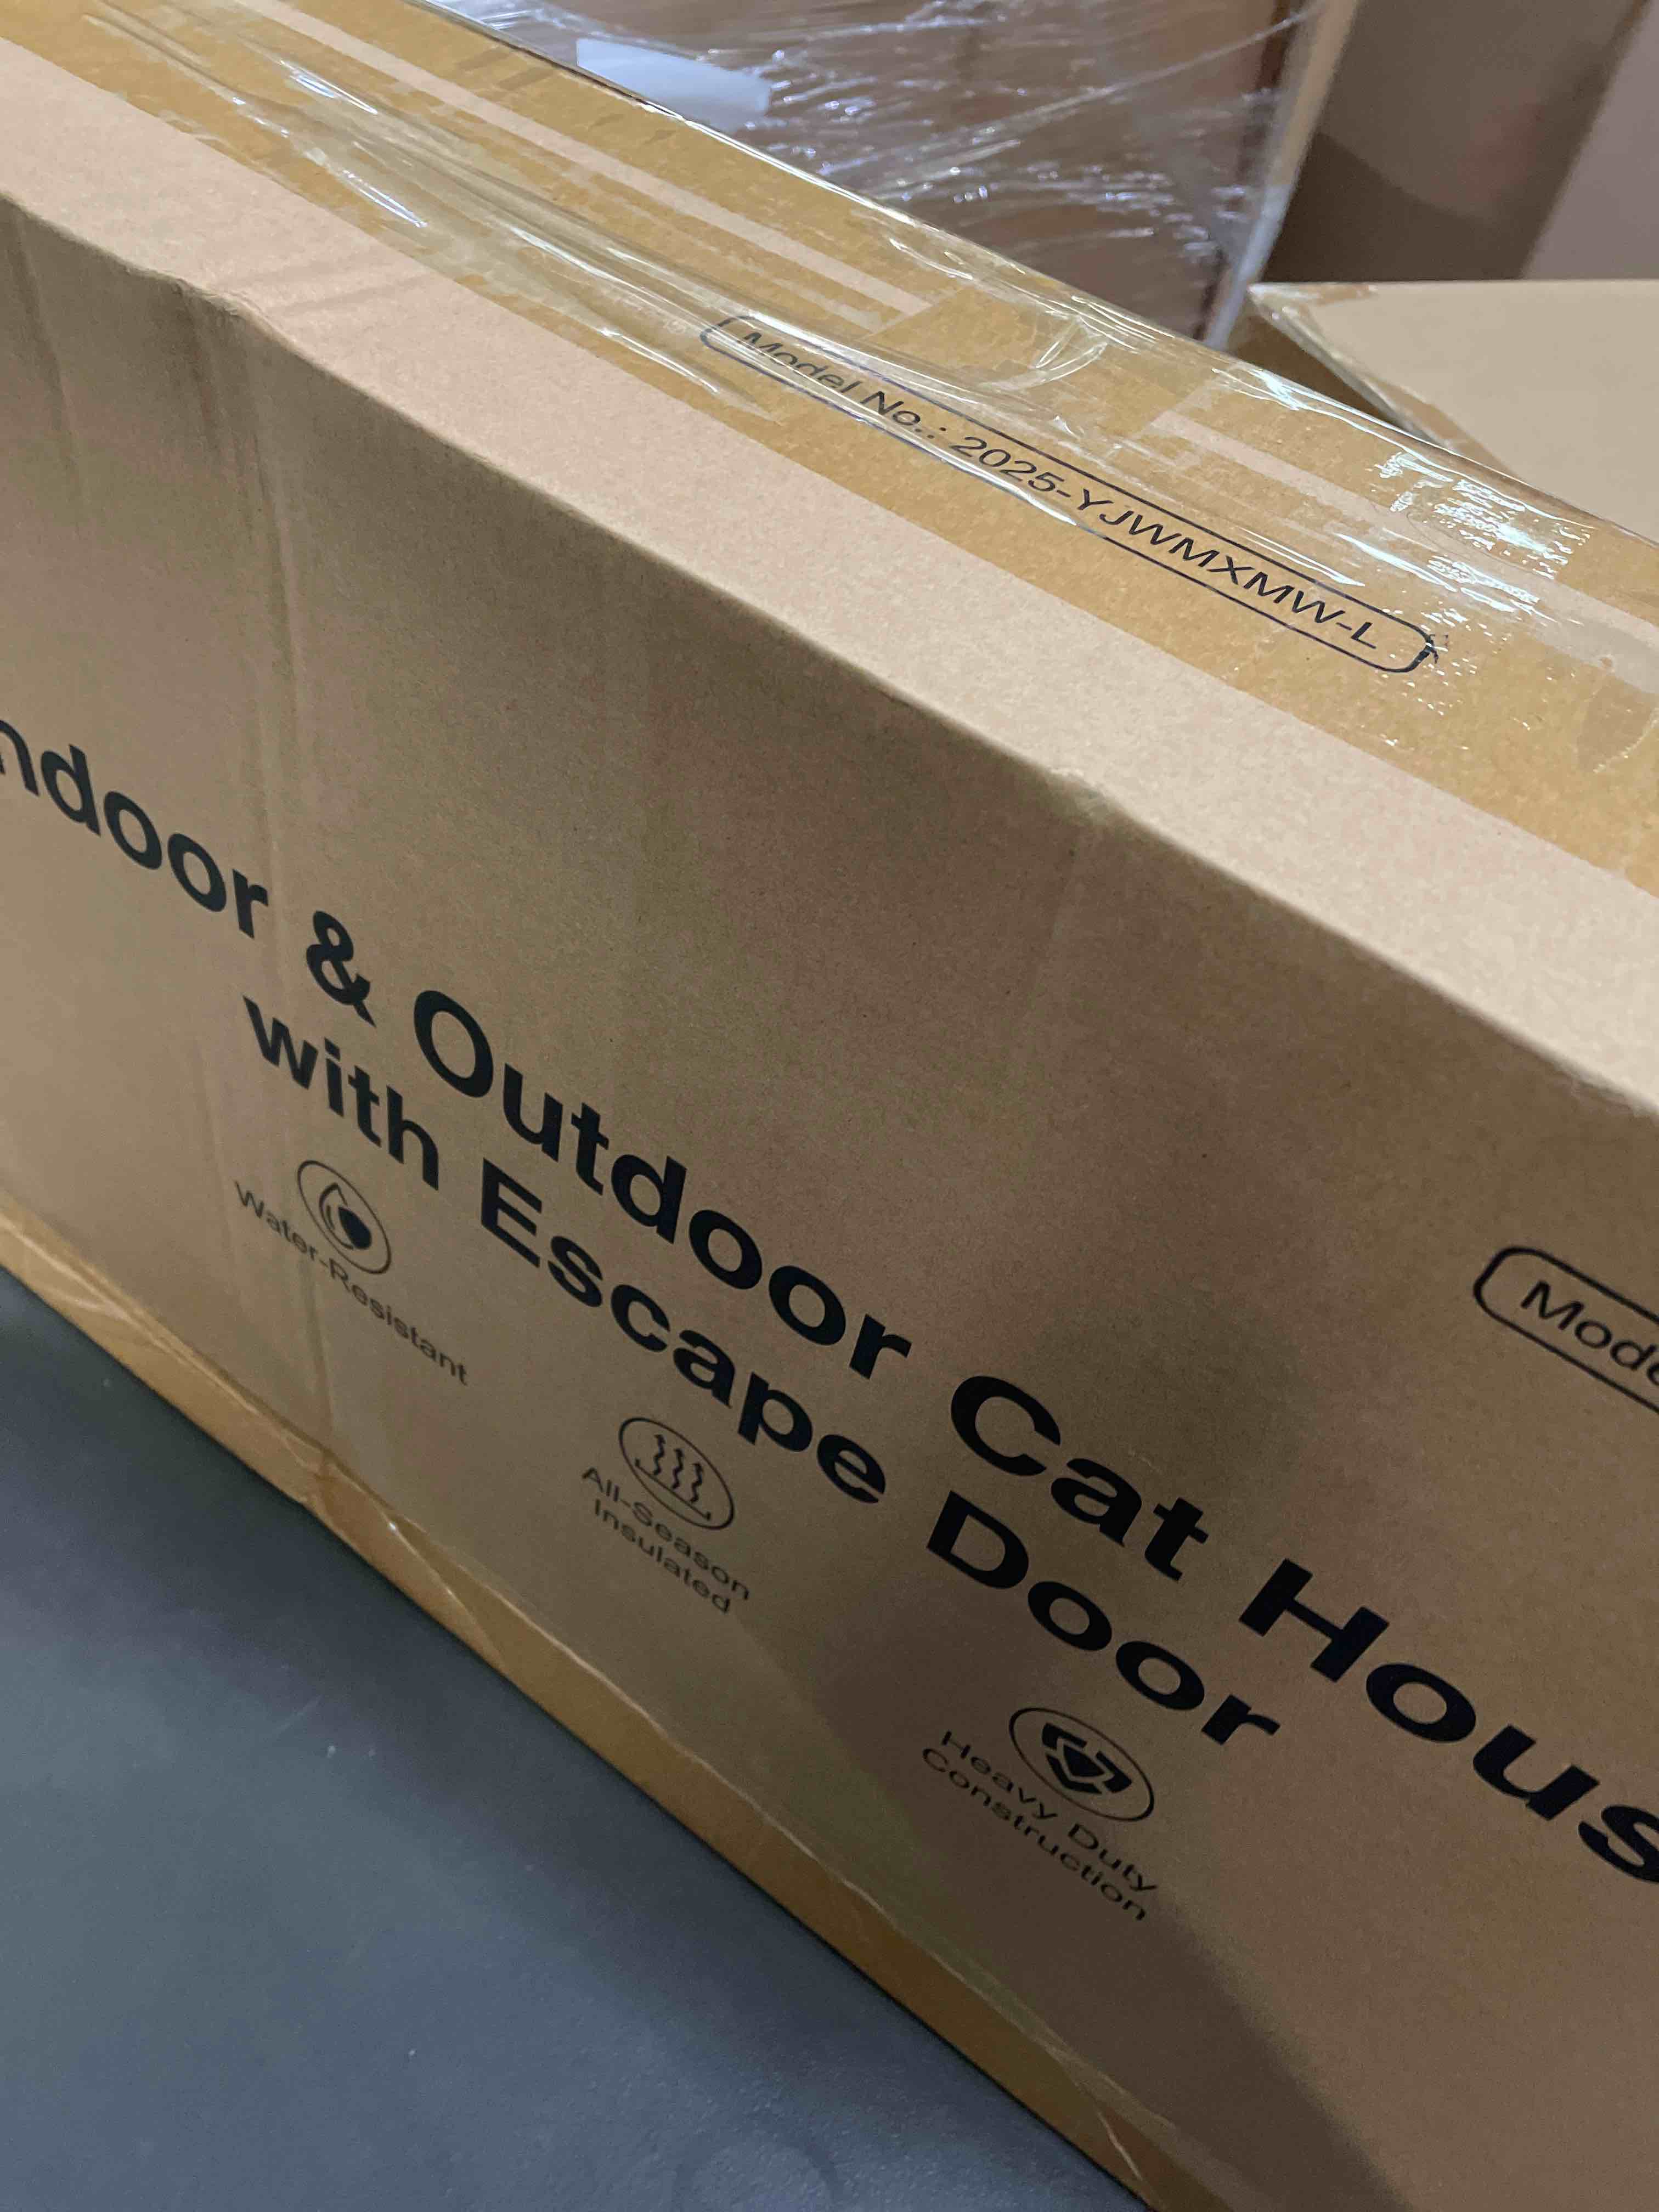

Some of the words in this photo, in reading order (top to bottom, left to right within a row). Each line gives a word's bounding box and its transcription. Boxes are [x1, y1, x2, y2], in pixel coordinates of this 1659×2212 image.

[737, 332, 862, 393] Model
[861, 391, 947, 438] No.:
[951, 436, 1376, 649] 2025-YJWMXMW-L
[235, 1180, 467, 1386] Water-Resistant
[306, 911, 376, 1028] &
[414, 990, 912, 1380] Outdoor
[950, 1376, 1209, 1581] Cat
[242, 995, 439, 1190] with
[481, 1158, 886, 1504] Escape
[927, 1490, 1280, 1745] Door
[582, 1468, 749, 1600] All-Season
[595, 1498, 730, 1613] Insulated
[922, 1748, 1146, 1921] Construction
[940, 1730, 1058, 1820] Heavy
[1068, 1823, 1158, 1892] Duty
